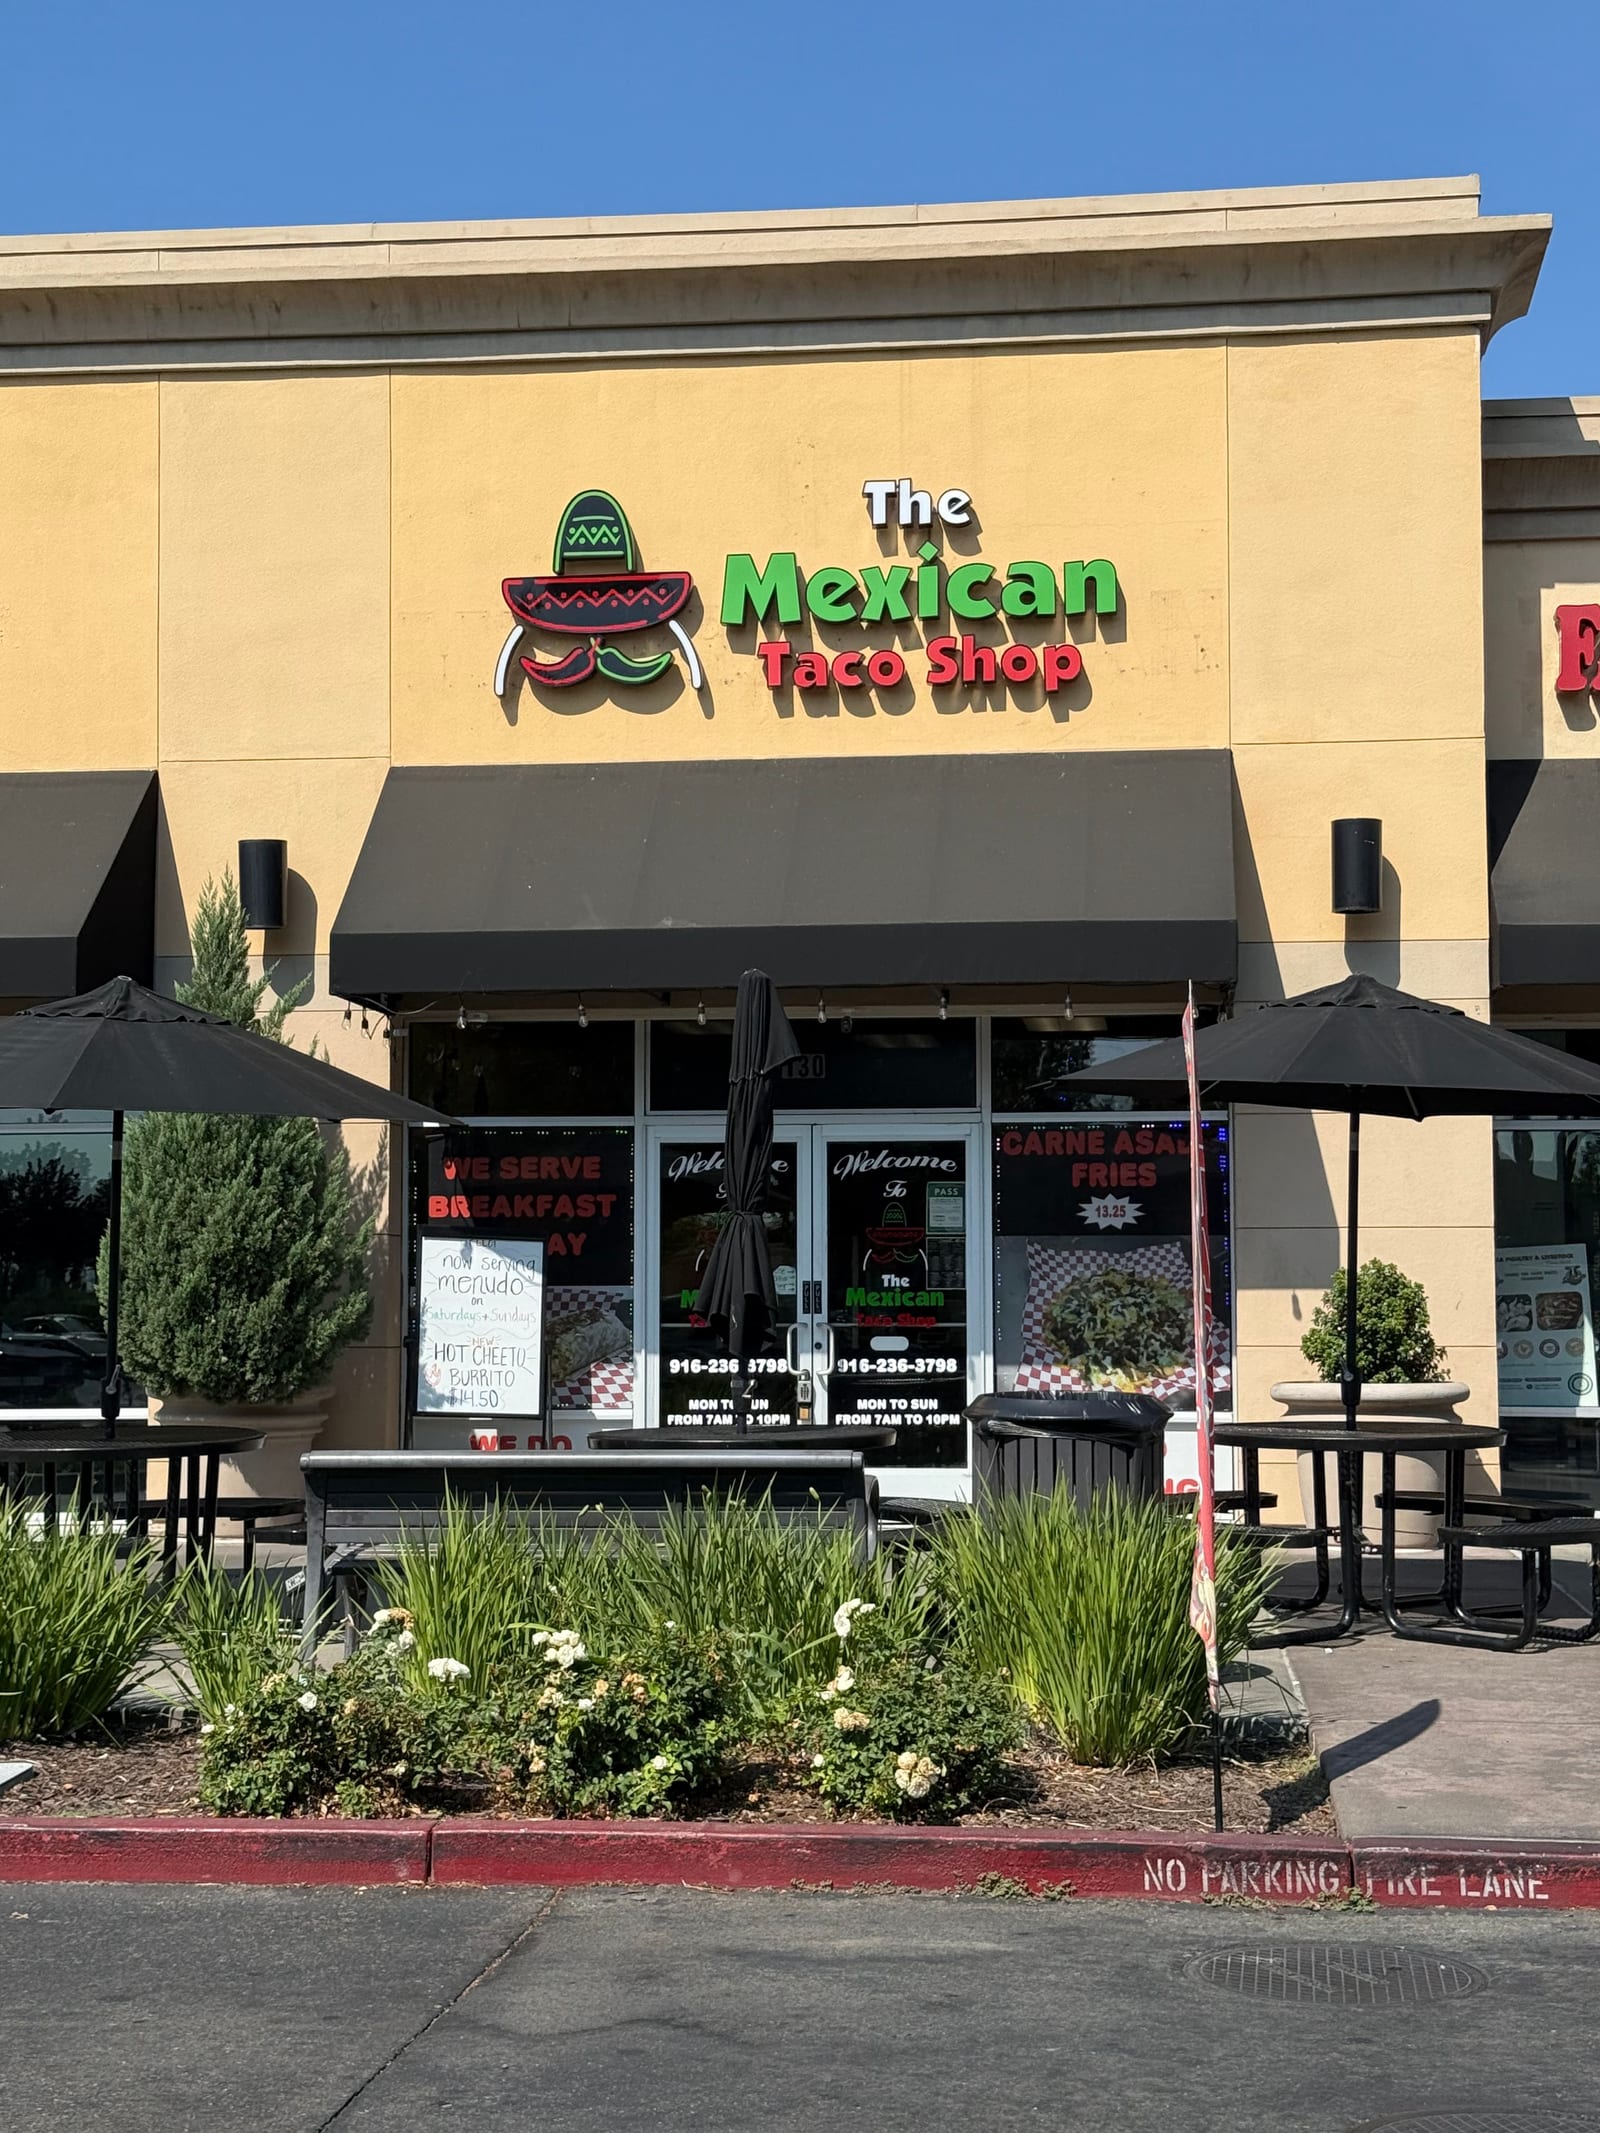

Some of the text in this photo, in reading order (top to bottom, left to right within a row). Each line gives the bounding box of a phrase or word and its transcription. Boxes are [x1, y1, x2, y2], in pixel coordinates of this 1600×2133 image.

[863, 479, 972, 528] The
[720, 542, 1118, 625] Mexican
[759, 634, 1084, 692] Taco Shop
[1003, 1130, 1191, 1156] CARNE ASA
[444, 1156, 602, 1180] WE SERVE
[667, 1151, 789, 1183] Welce
[833, 1149, 958, 1181] Welcome
[1071, 1162, 1158, 1188] FRIES
[934, 1187, 960, 1197] PASS
[428, 1195, 617, 1219] BREAKFAST
[546, 1232, 587, 1256] AY
[443, 1255, 536, 1281] now serving
[438, 1272, 525, 1297] menudo
[881, 1274, 911, 1288] The
[471, 1297, 485, 1306] on
[845, 1287, 945, 1308] Mexican
[490, 1305, 537, 1329] Sundays
[856, 1312, 938, 1329] Taco Shop
[434, 1342, 469, 1363] HOT
[669, 1358, 788, 1374] 916-2363798
[837, 1358, 958, 1373] 916-236-3798
[449, 1368, 516, 1388] BURRITO
[688, 1398, 719, 1410] MON
[857, 1398, 939, 1410] MON TO SUN
[667, 1414, 703, 1425] FROM
[706, 1414, 733, 1425] 7AM
[756, 1414, 791, 1425] 10PM
[835, 1414, 960, 1426] FROM 7AM TO 10PM
[1144, 1858, 1186, 1892] NO
[1202, 1859, 1340, 1894] PARKING
[1459, 1865, 1549, 1900] LANE
